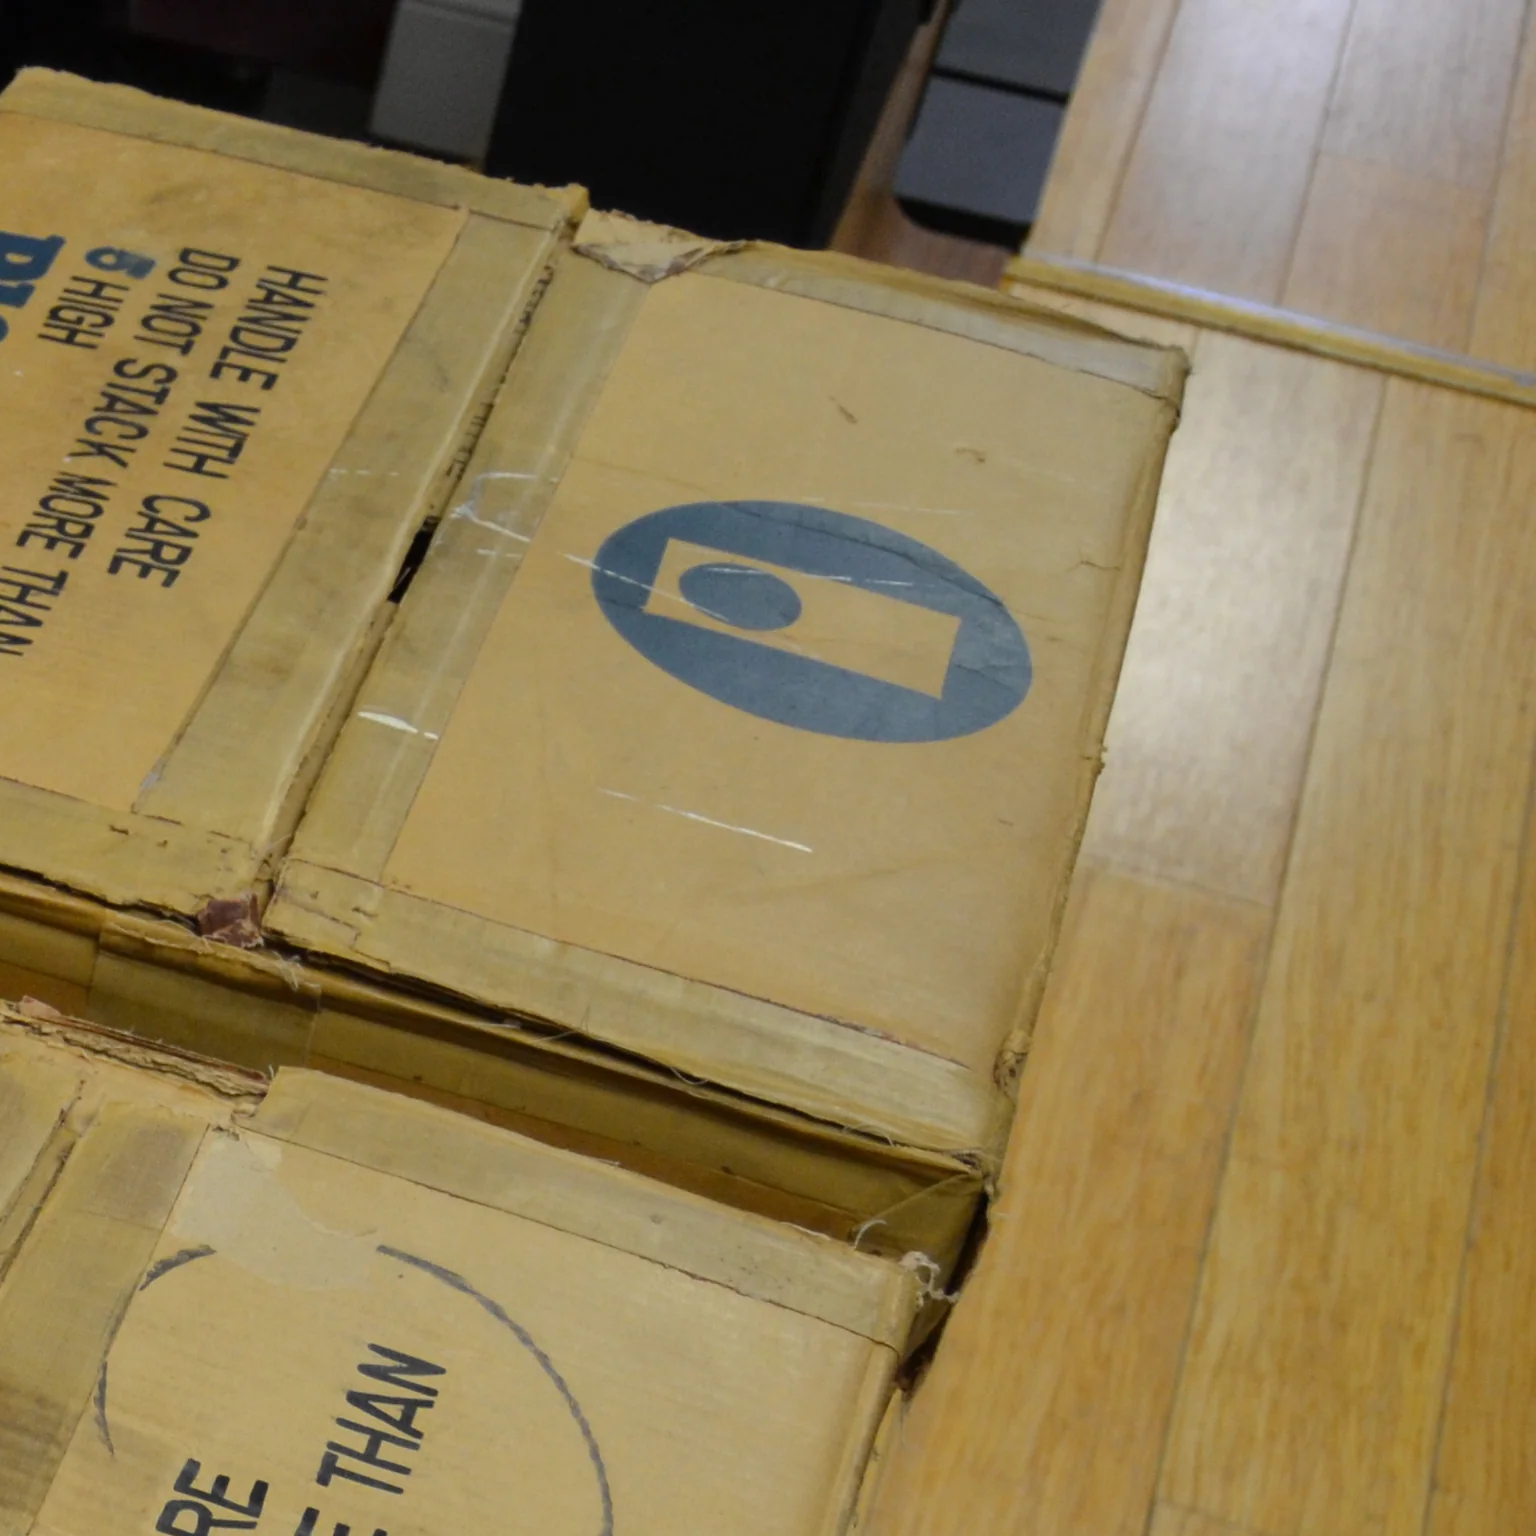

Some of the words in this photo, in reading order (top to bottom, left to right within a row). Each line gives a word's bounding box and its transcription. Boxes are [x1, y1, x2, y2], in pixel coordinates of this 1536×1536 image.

[167, 246, 241, 291] DO
[37, 275, 130, 350] HIGH
[135, 294, 213, 355] NOT
[210, 266, 326, 390] HANDLE
[69, 358, 178, 469] STACK
[164, 402, 259, 478] WITH
[17, 477, 113, 558] MORE
[107, 494, 211, 588] CARE
[318, 1343, 446, 1494] THAN
